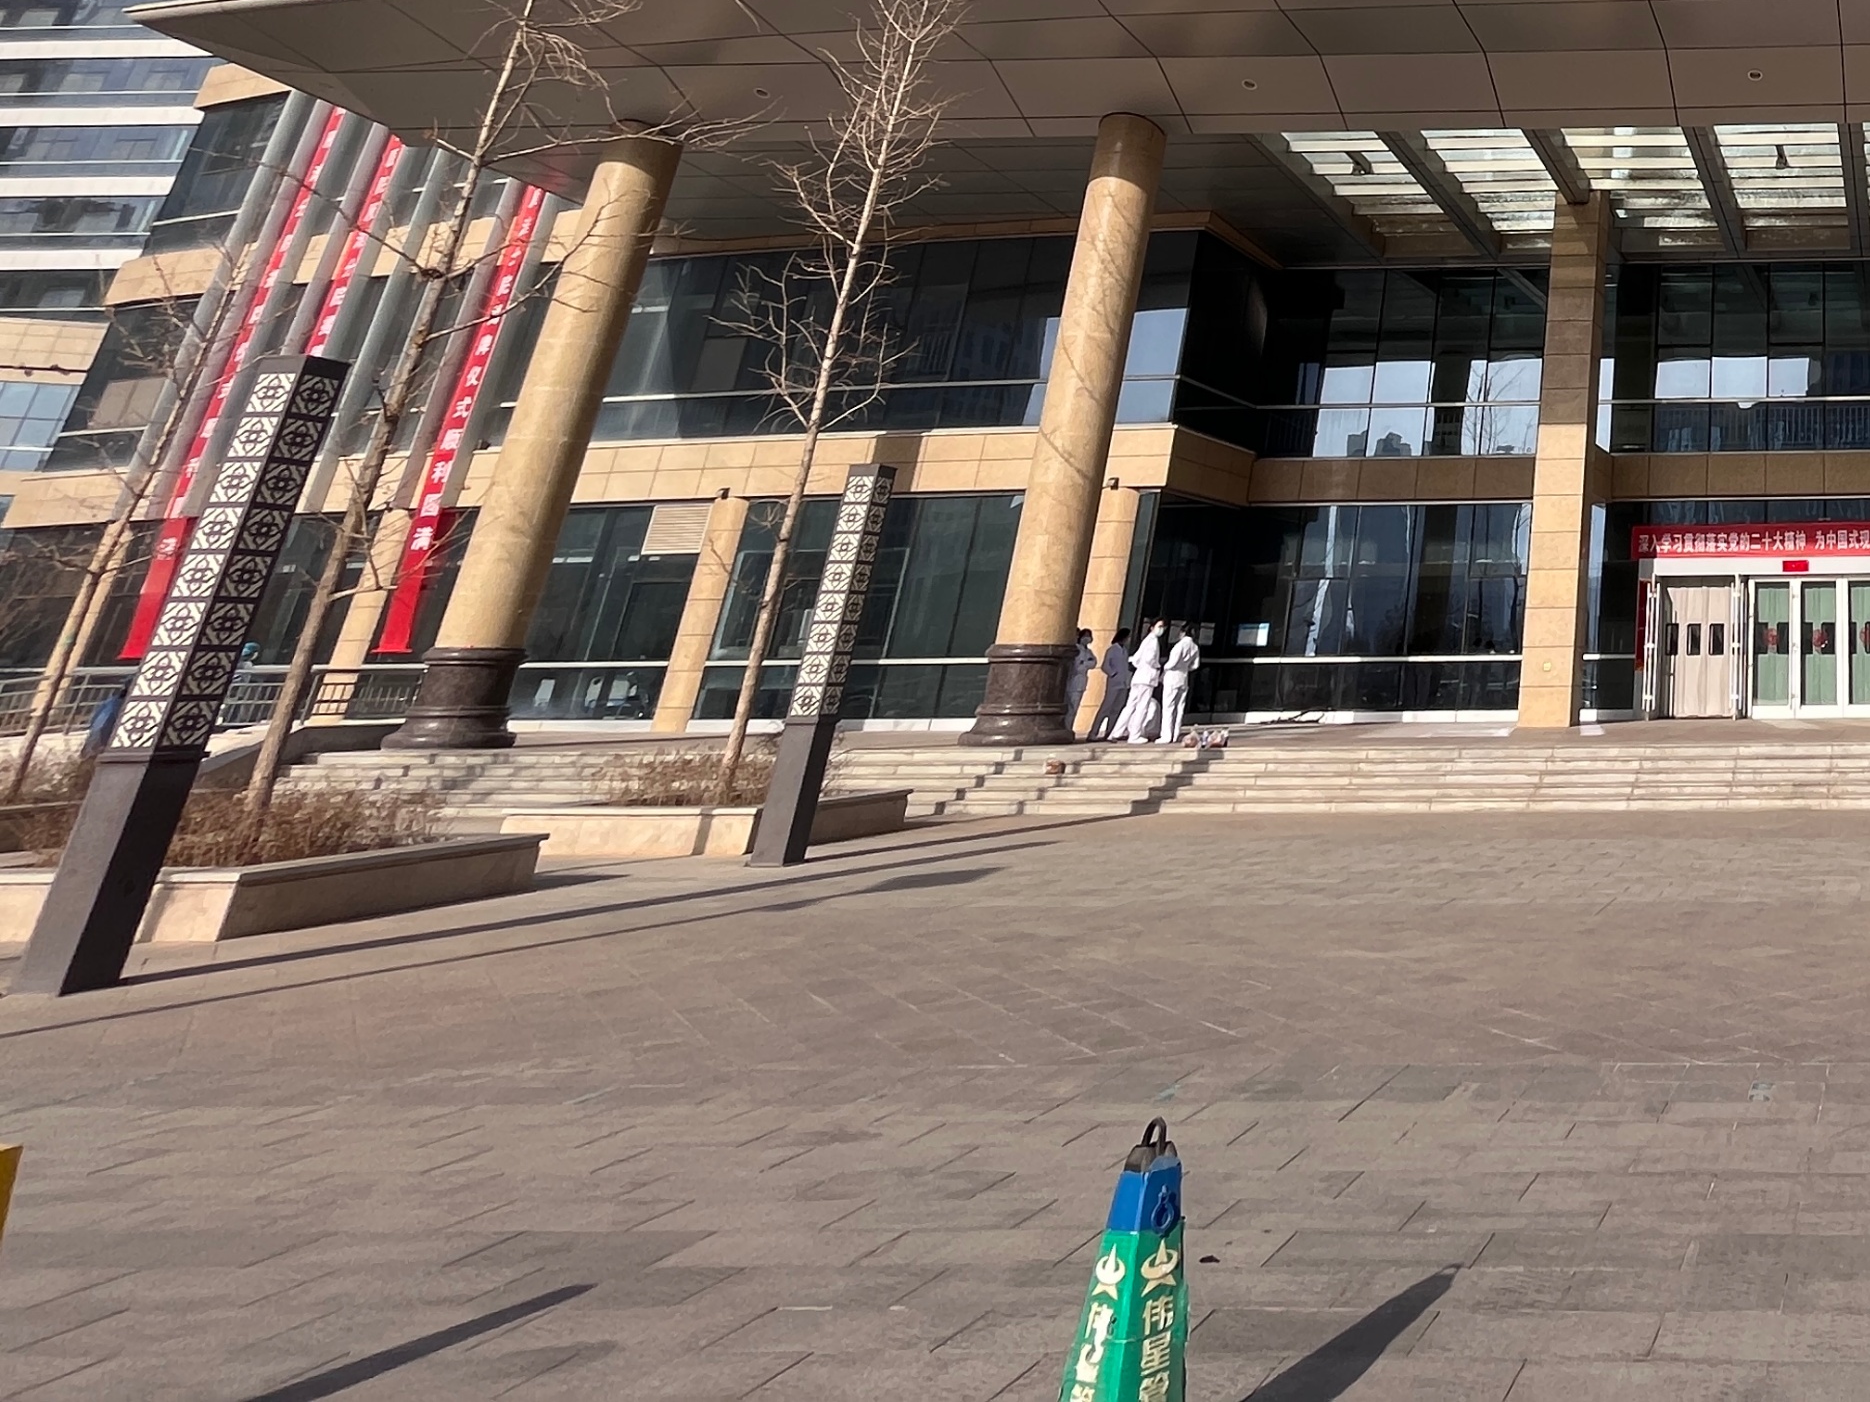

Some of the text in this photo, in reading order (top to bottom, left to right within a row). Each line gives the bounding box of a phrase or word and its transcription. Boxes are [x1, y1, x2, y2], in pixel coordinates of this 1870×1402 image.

[1638, 530, 1807, 554] 深入学习贯彻落实党的二十大精神
